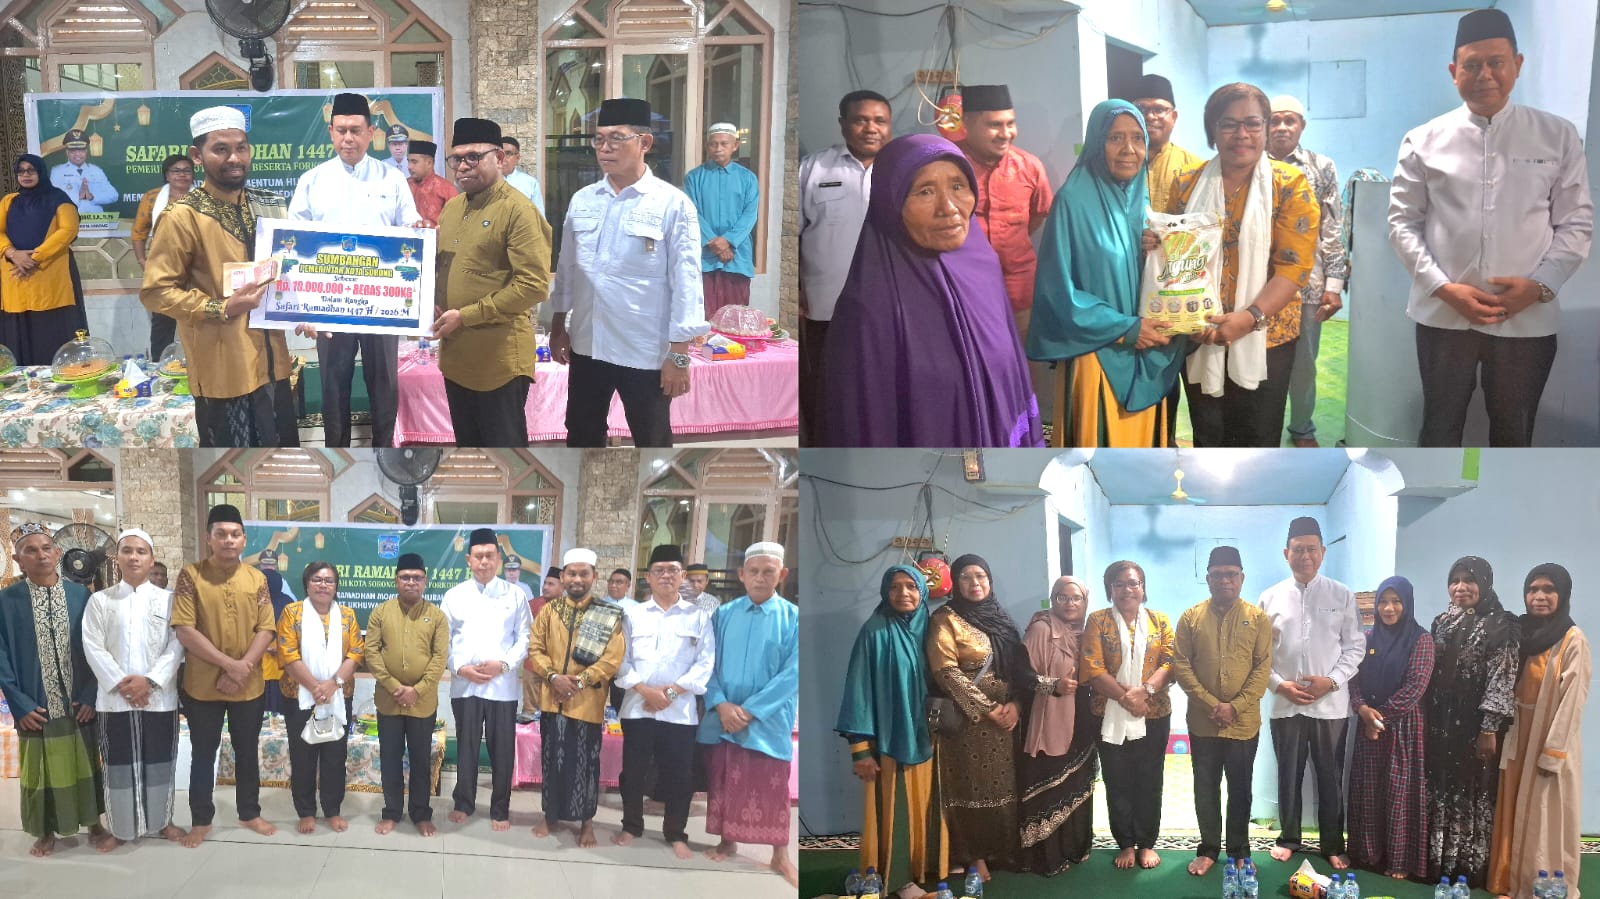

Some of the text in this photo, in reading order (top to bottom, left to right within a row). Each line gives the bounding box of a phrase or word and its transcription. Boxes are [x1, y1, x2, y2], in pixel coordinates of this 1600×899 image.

[297, 143, 334, 159] 1447
[252, 162, 292, 172] BESERTA
[316, 253, 380, 268] SUMBANGAN
[353, 283, 381, 296] BERAS
[383, 285, 413, 299] 300KG
[276, 301, 300, 312] Safari
[301, 303, 345, 313] Ramadhan
[431, 567, 463, 580] 1447
[348, 580, 367, 588] KOTA
